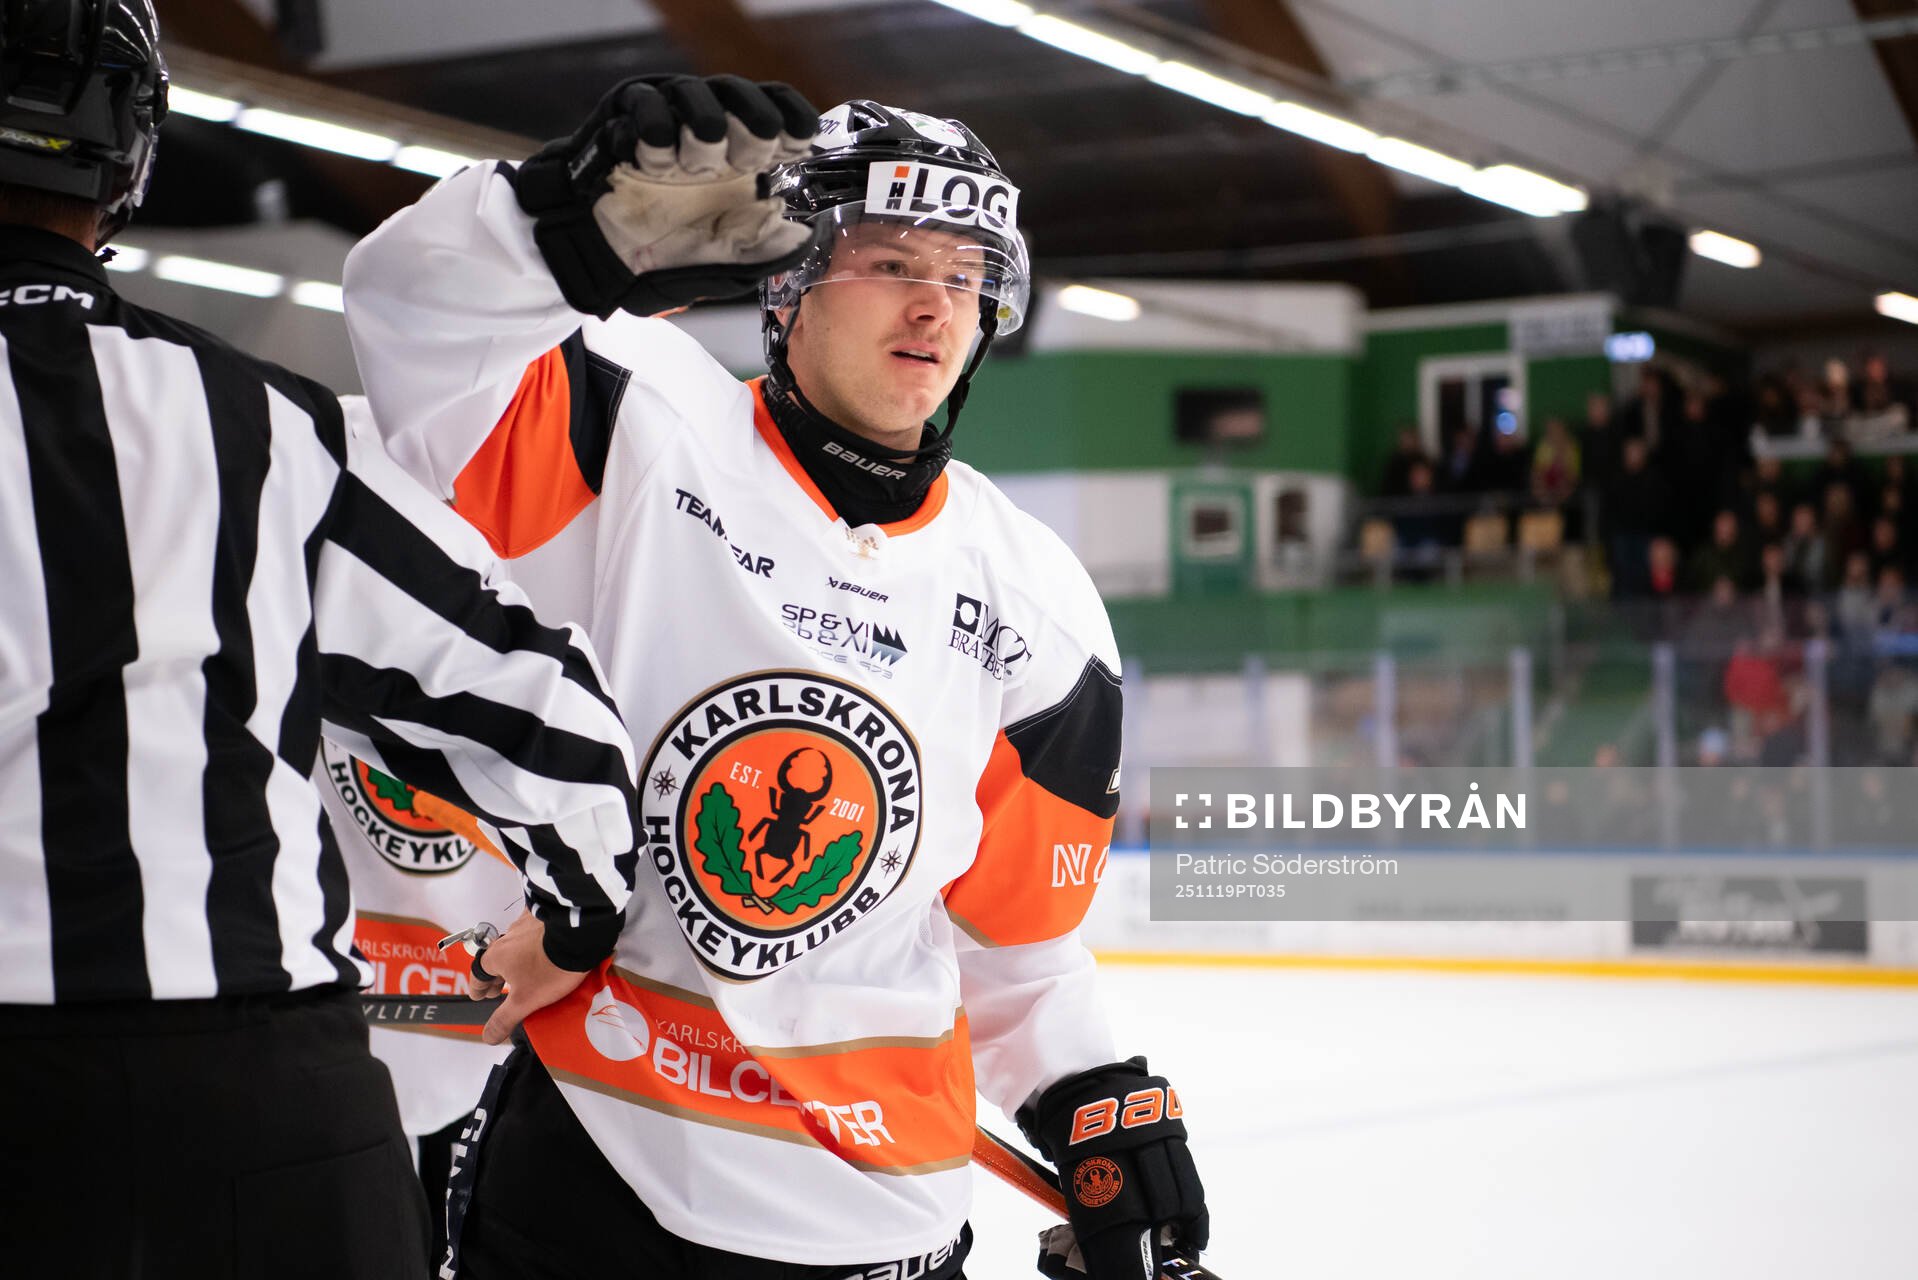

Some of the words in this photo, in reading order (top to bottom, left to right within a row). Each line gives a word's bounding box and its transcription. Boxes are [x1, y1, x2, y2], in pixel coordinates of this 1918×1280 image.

[671, 684, 915, 833] KARLSKRONA
[730, 761, 762, 789] EST.
[330, 762, 474, 864] HOCKEYKL
[829, 797, 865, 823] 2001
[645, 815, 881, 970] HOCKEYKLUBB
[353, 939, 449, 964] ARLSKRONA
